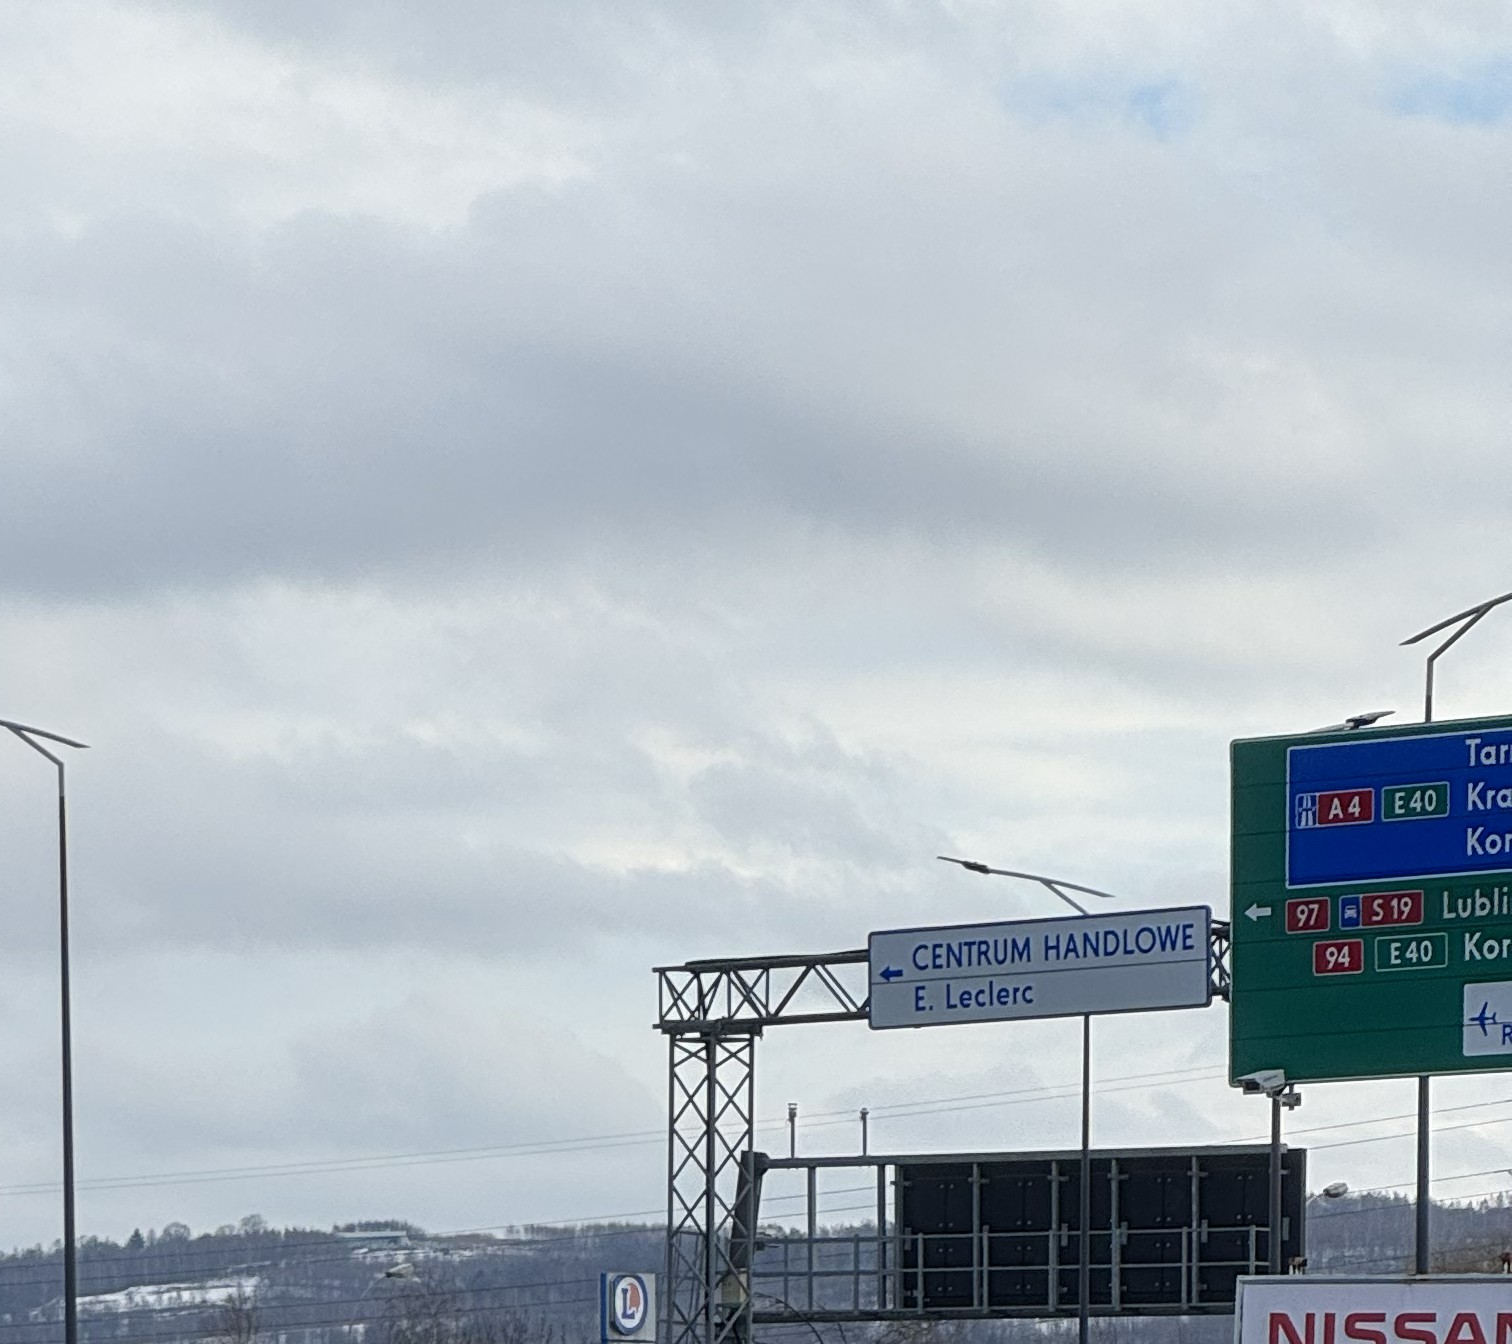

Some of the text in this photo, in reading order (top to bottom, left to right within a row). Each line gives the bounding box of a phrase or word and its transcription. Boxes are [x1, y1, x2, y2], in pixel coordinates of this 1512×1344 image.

[1467, 782, 1512, 811] Kra
[1296, 904, 1319, 928] 97
[1443, 886, 1512, 919] Lubli
[912, 923, 1195, 971] CENTRUM HANDLOWE
[1325, 945, 1351, 970] 94
[1464, 932, 1511, 962] Kor
[914, 981, 1035, 1012] E. Leclerc
